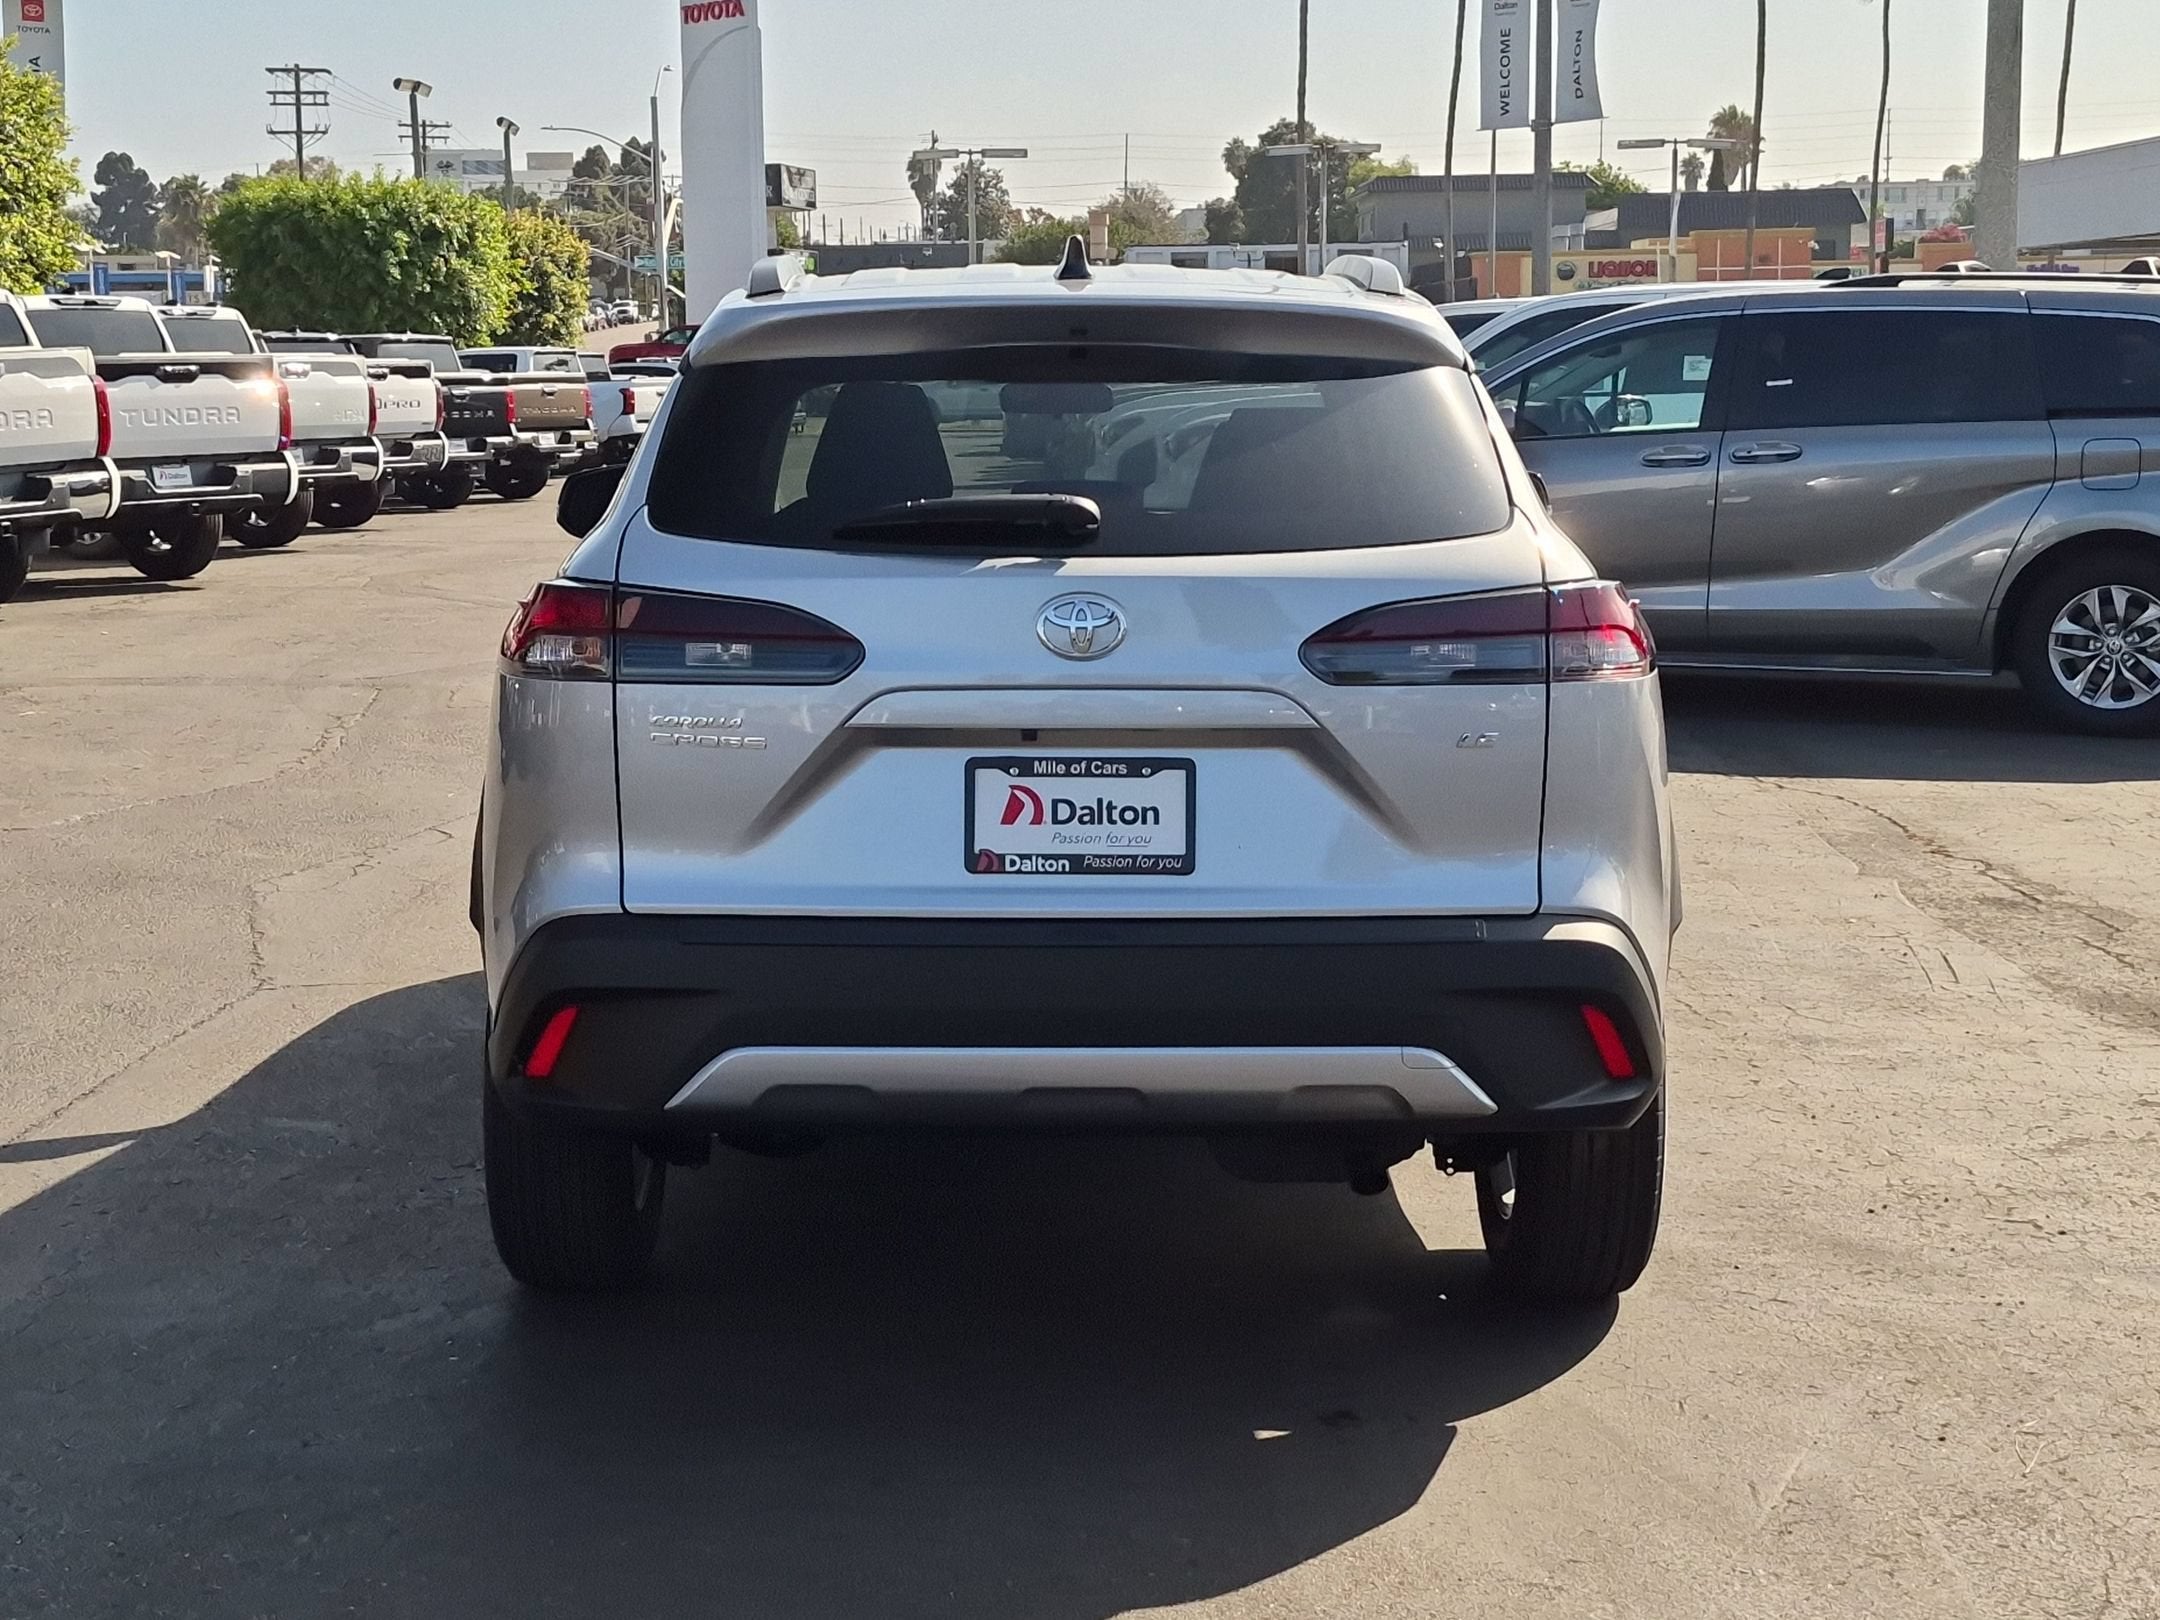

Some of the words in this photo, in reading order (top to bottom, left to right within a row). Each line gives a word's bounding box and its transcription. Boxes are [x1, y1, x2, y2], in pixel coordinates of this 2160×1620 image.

[681, 0, 745, 24] TOYOTA
[17, 25, 51, 34] TOYOTA
[1500, 28, 1511, 116] WELCOME
[1573, 30, 1584, 99] DALTON
[119, 406, 241, 427] TUNDRA
[650, 715, 743, 729] COROLLA
[650, 732, 767, 750] CROSS
[1456, 731, 1500, 748] LE
[1033, 760, 1067, 775] Mile
[1069, 760, 1087, 775] of
[1090, 760, 1128, 775] Cars
[1051, 797, 1160, 826] Dalton
[1051, 832, 1102, 845] Passion
[1105, 831, 1126, 845] for
[1127, 835, 1152, 847] you
[1004, 854, 1070, 873] Dalton
[1083, 855, 1132, 868] Passion
[1136, 854, 1156, 868] for
[1157, 857, 1183, 869] you
